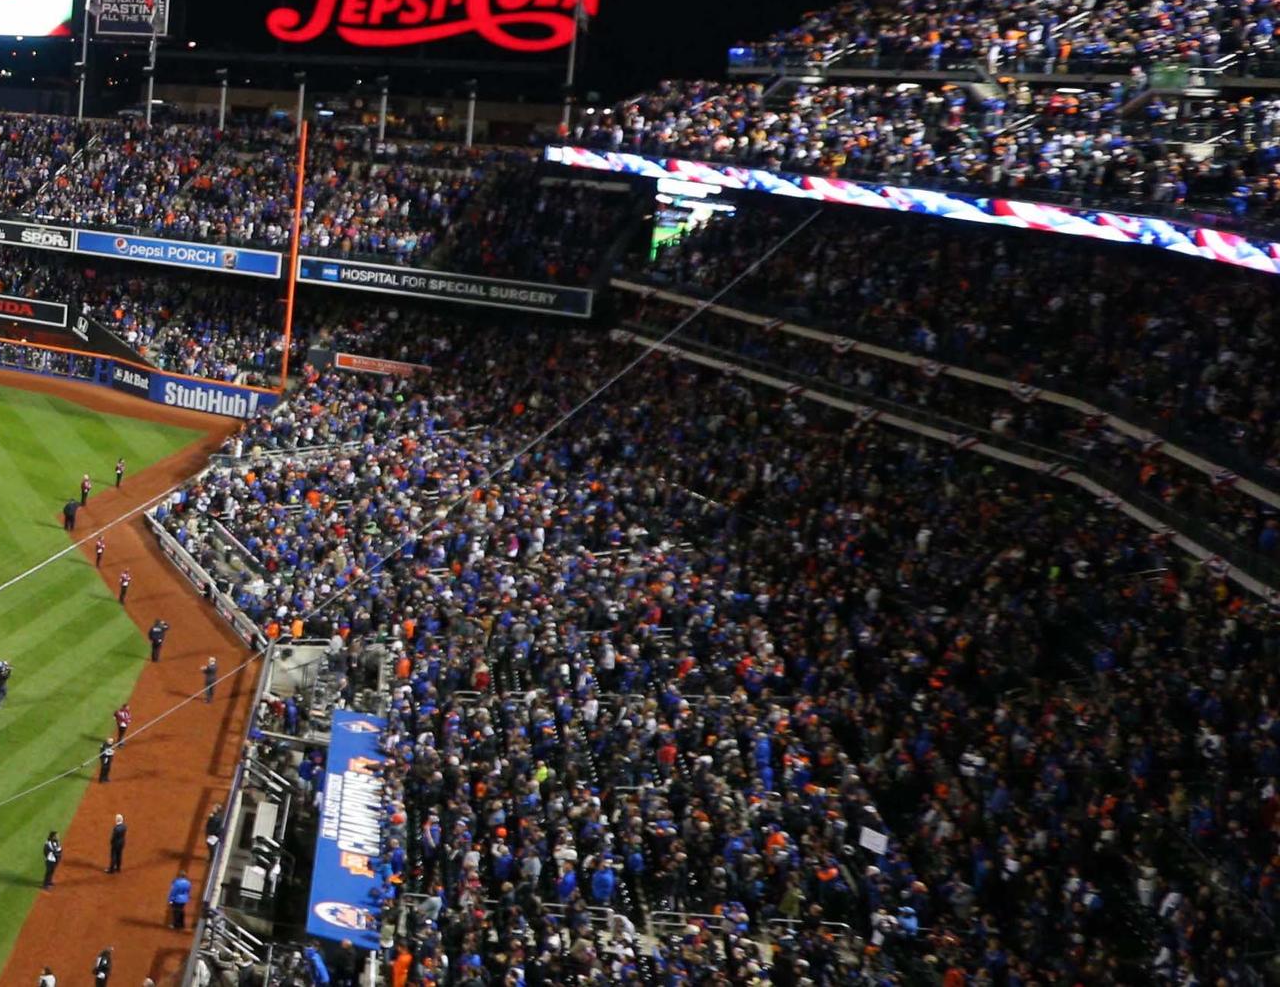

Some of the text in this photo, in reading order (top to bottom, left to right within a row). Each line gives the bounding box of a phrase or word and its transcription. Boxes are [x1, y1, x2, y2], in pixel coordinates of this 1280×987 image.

[129, 245, 216, 264] pepsi PORCH
[341, 268, 399, 286] HOSPITAL
[402, 276, 426, 288] FOR
[428, 278, 486, 296] SPECIAL
[489, 287, 558, 304] SURGERY
[122, 370, 150, 390] At Bat
[165, 381, 259, 419] StubHub!
